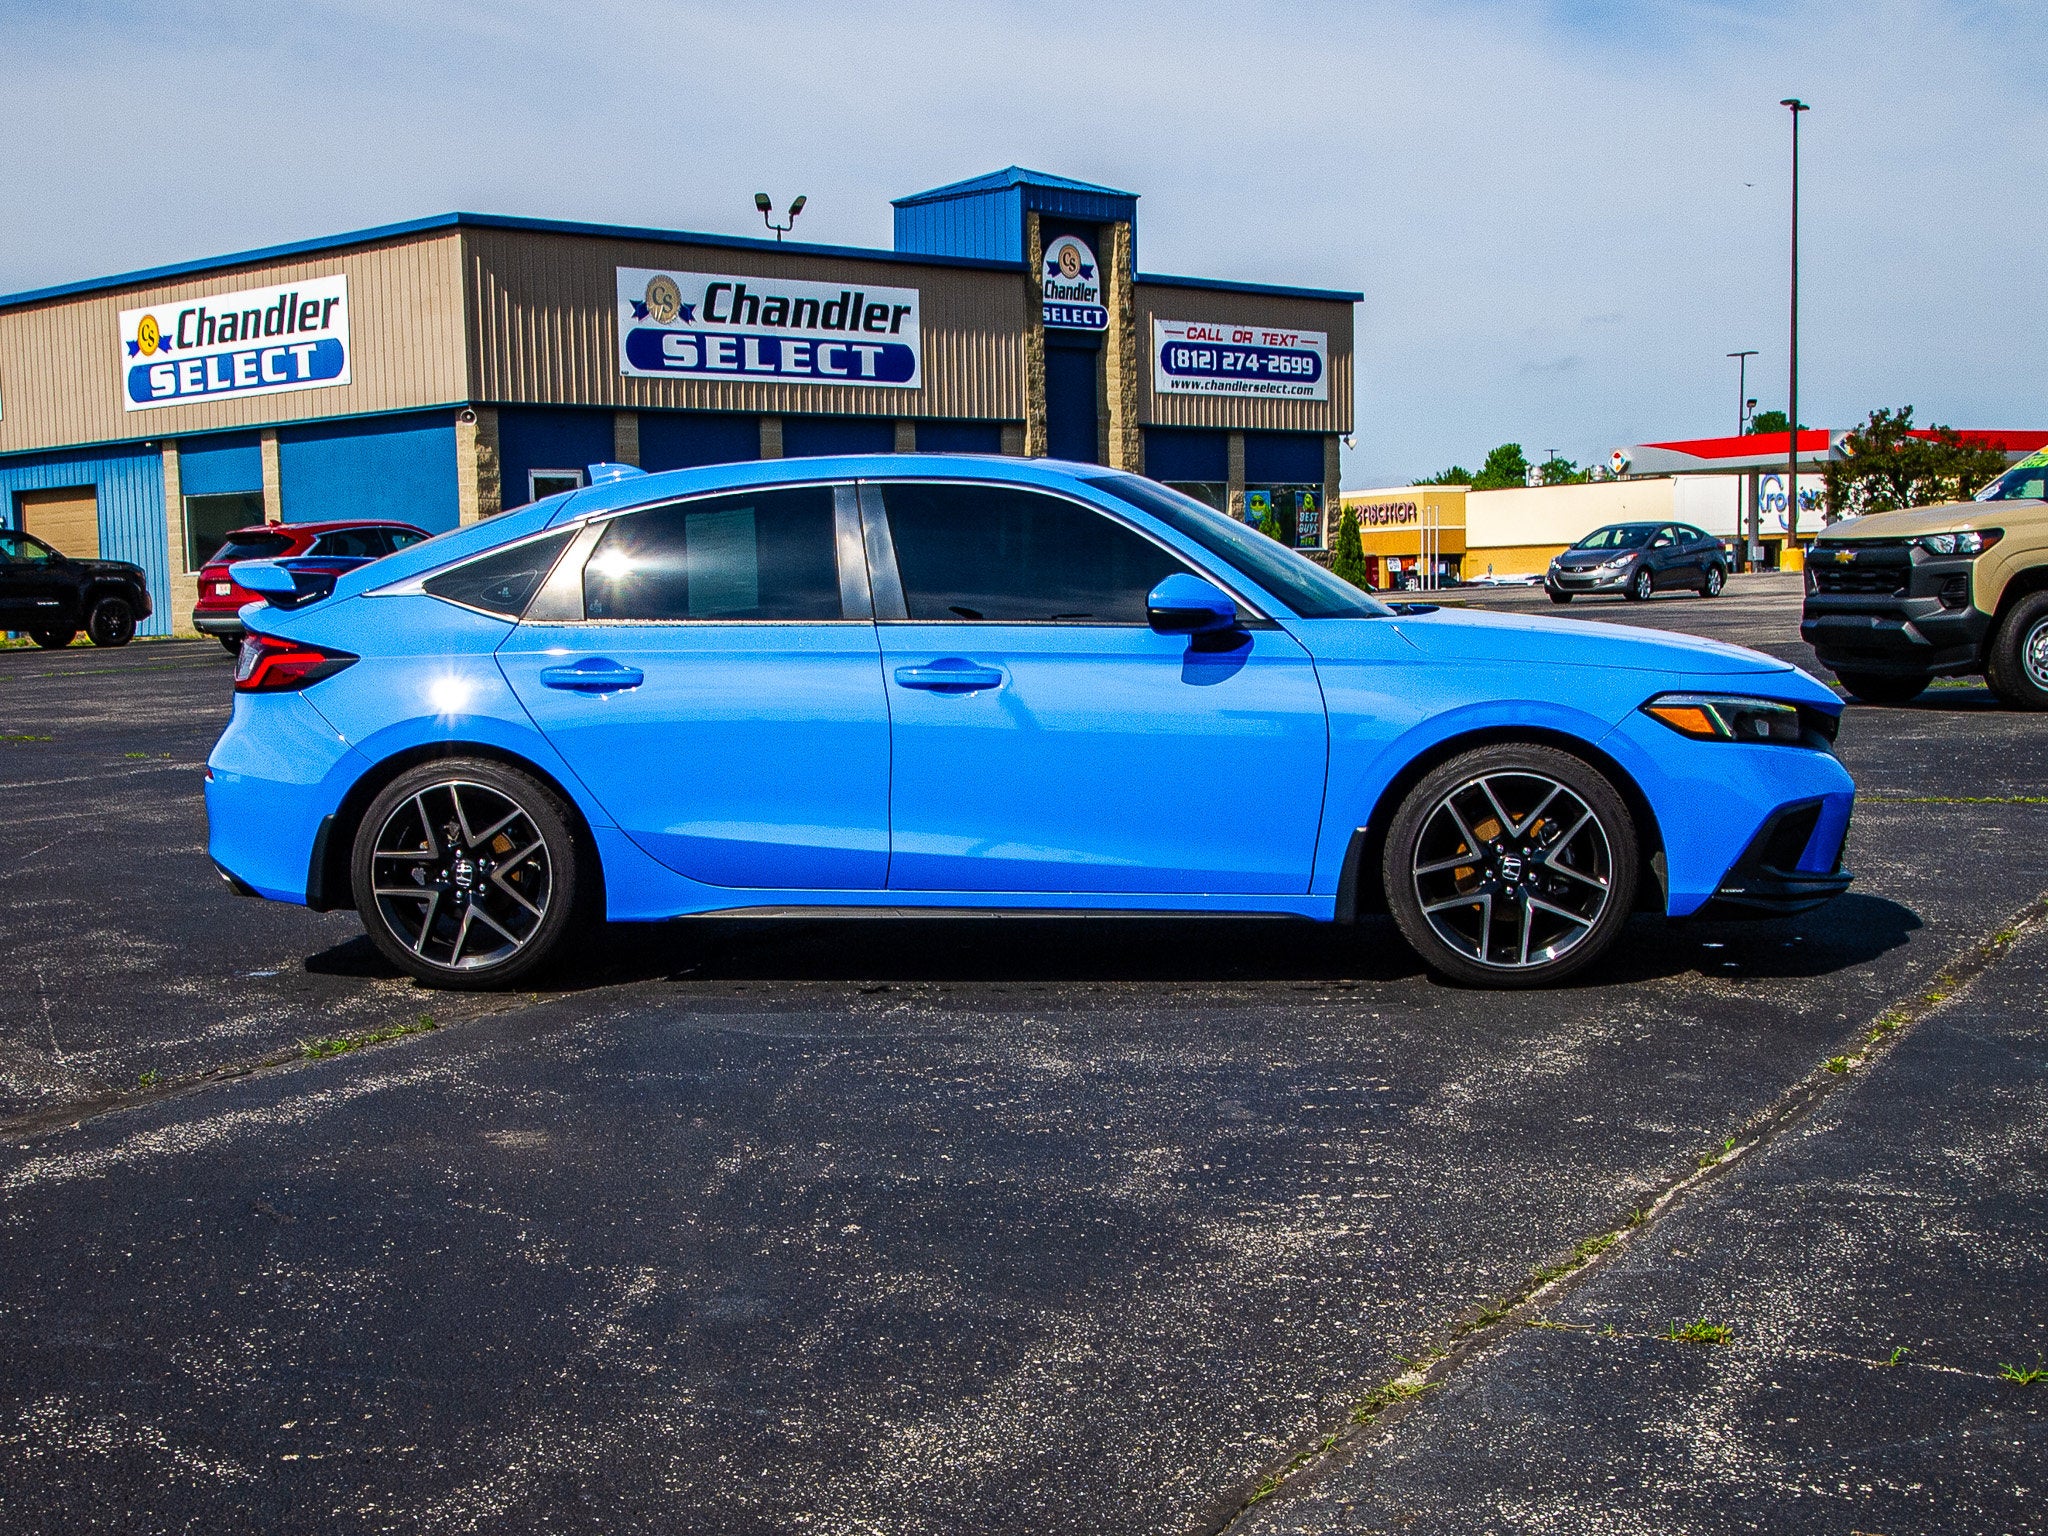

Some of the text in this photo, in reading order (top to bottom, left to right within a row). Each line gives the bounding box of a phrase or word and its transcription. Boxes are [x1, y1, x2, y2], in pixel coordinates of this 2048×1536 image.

[1044, 279, 1098, 303] Chandler
[702, 281, 912, 334] Chandler
[1043, 307, 1103, 325] SELECT
[176, 291, 340, 350] Chandler
[1186, 327, 1299, 347] CALL OR TEXT
[662, 333, 884, 377] SELECT
[1170, 347, 1314, 375] (812) 274-2699
[150, 342, 317, 398] SELECT
[1170, 379, 1314, 396] www.chandlerselect.com
[1298, 523, 1319, 534] GUYS
[1299, 512, 1319, 522] BEST
